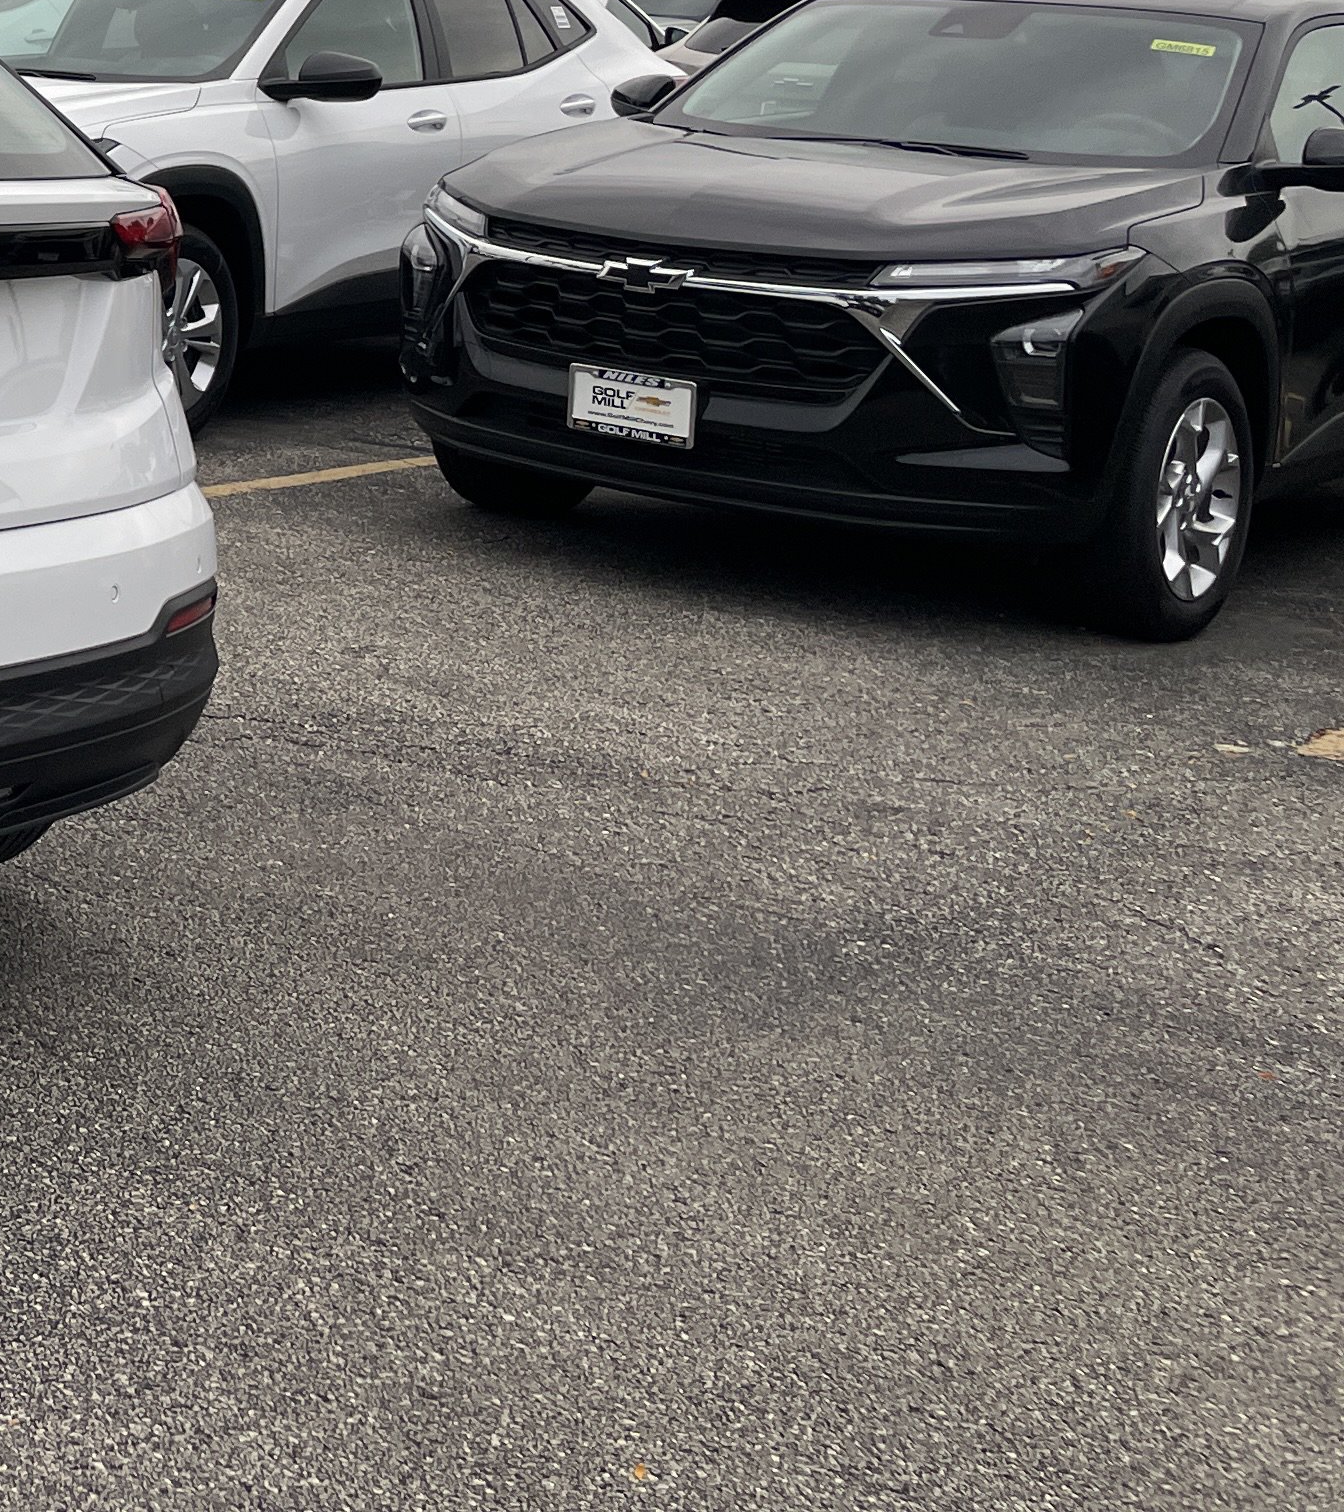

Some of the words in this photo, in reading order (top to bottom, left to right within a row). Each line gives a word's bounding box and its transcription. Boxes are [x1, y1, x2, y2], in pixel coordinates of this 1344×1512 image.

[602, 371, 661, 387] NILES
[592, 386, 635, 400] GOLF
[592, 396, 626, 409] MILL
[597, 424, 630, 436] GOLF
[632, 430, 661, 442] MILL
